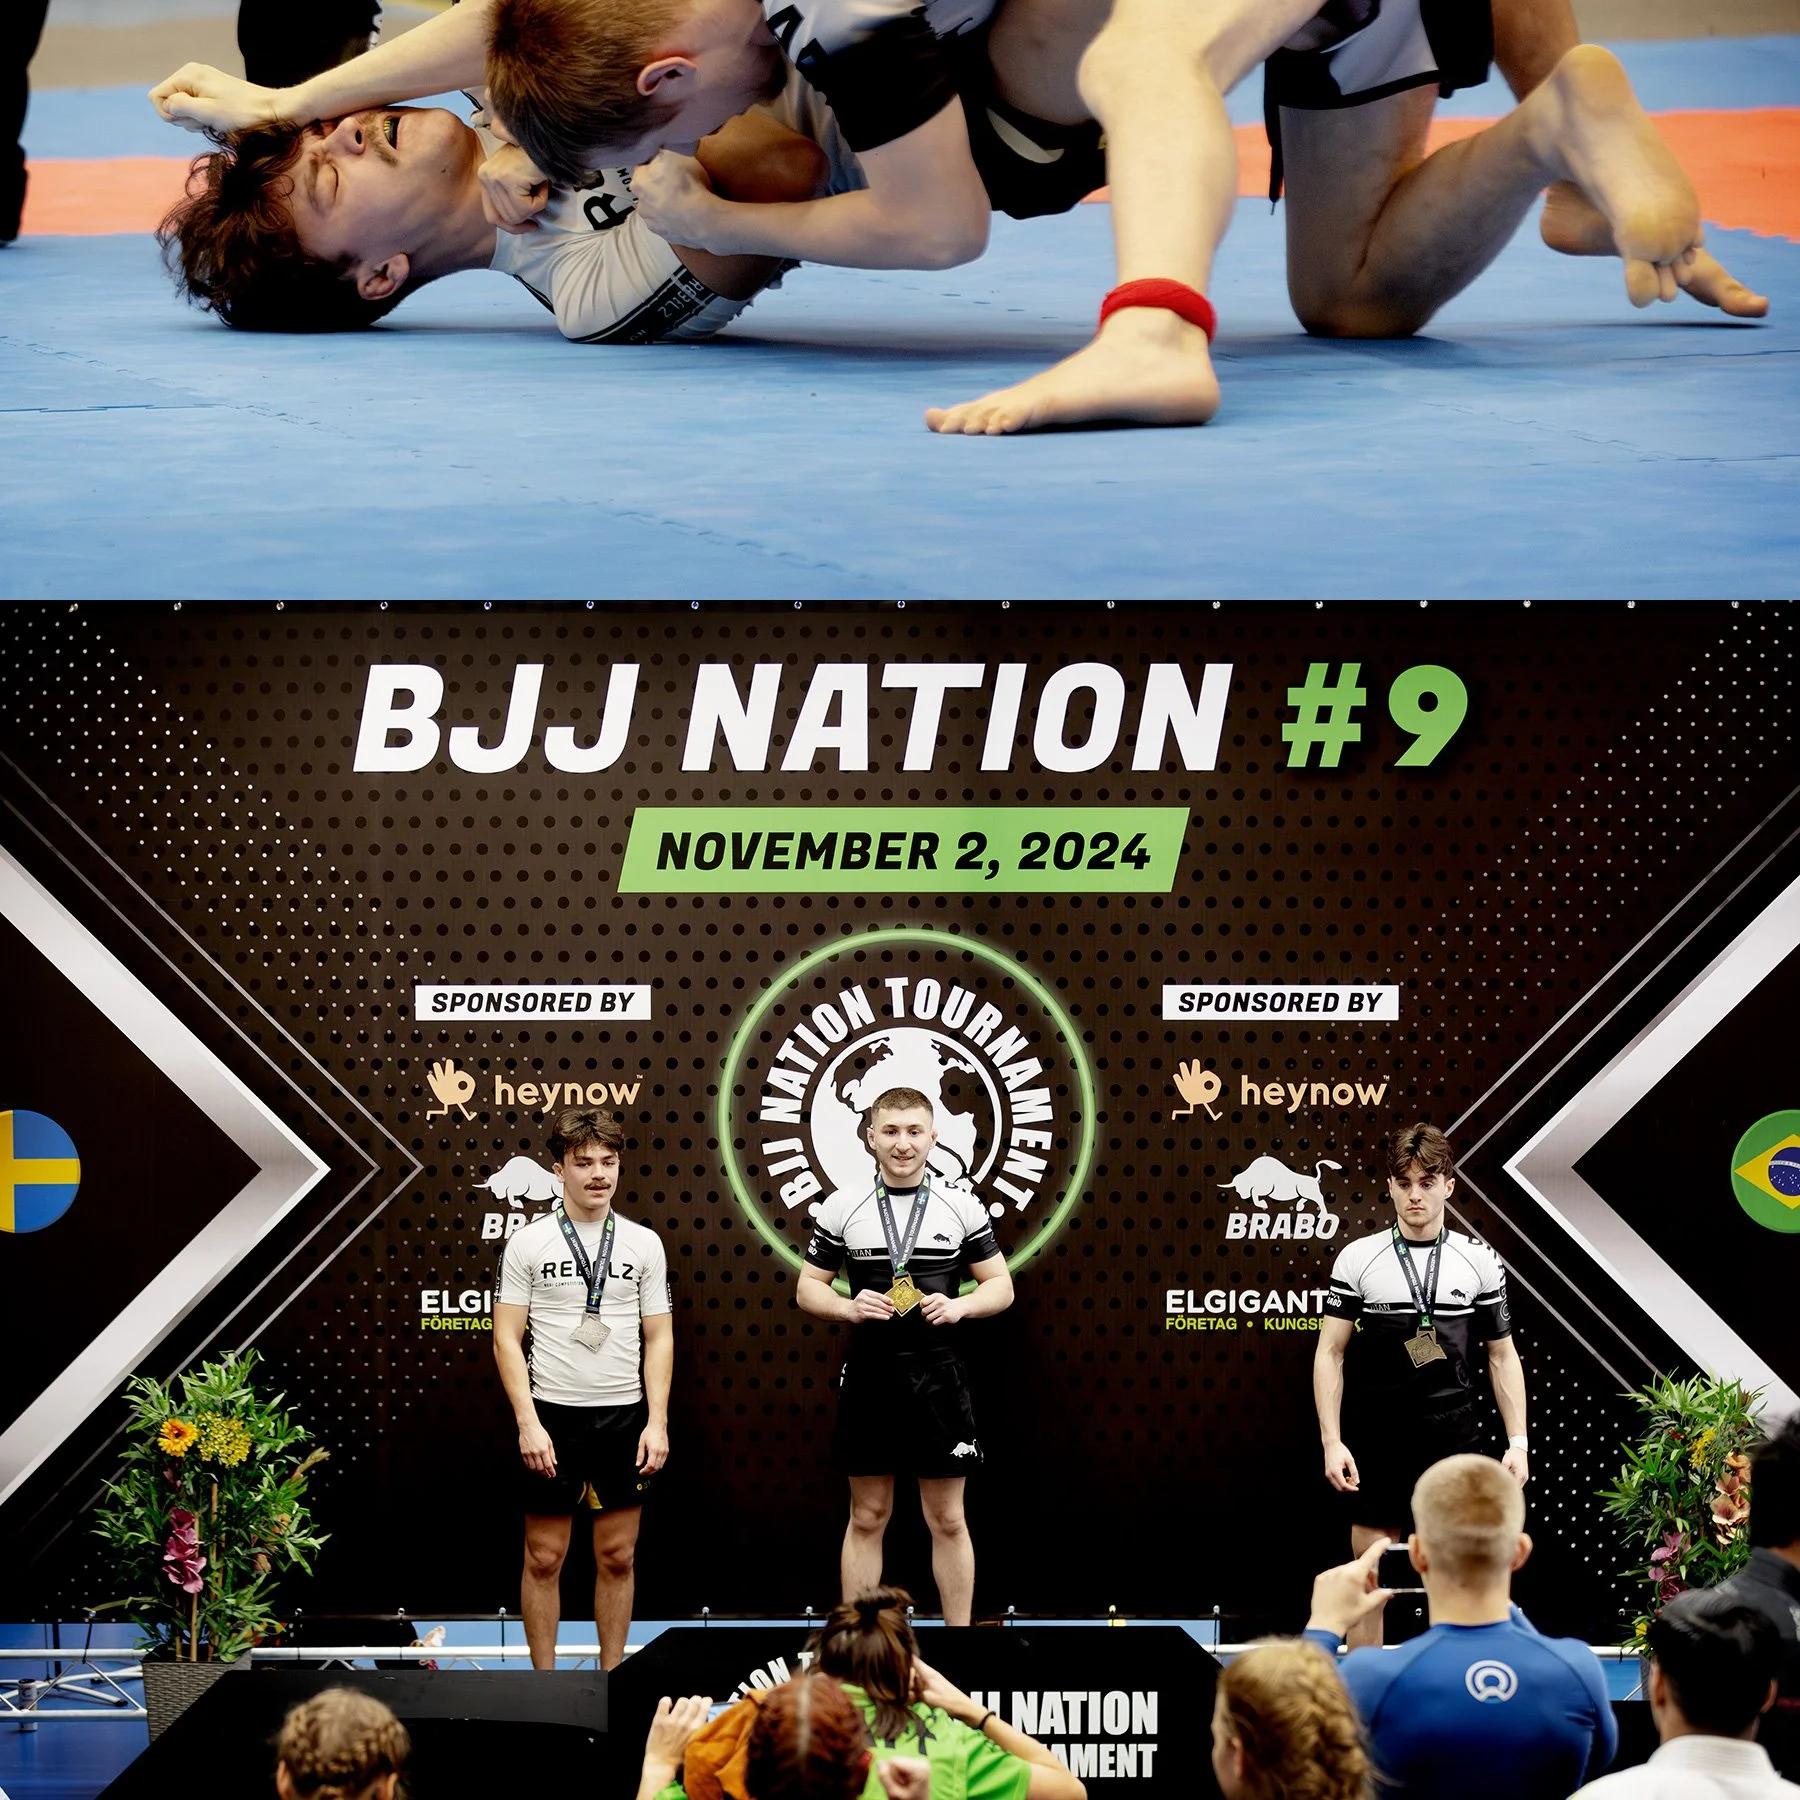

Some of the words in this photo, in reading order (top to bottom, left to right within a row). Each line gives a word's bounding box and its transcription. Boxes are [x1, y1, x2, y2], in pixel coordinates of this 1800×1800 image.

[353, 663, 640, 774] BJJ
[681, 662, 1234, 773] NATION
[1281, 662, 1469, 768] #9
[656, 831, 940, 871] NOVEMBER
[954, 831, 1000, 880] 2,
[1017, 831, 1151, 871] 2024
[431, 992, 592, 1013] SPONSORED
[600, 992, 635, 1012] BY
[1178, 991, 1340, 1013] SPONSORED
[1347, 991, 1384, 1012] BY
[760, 984, 877, 1124] NATION
[495, 1074, 641, 1113] heynow
[884, 976, 1054, 1212] TOURNAMENT
[1241, 1074, 1387, 1113] heynow
[761, 1137, 822, 1211] BJJ
[481, 1212, 538, 1239] BR
[1225, 1212, 1340, 1240] BRABO
[541, 1261, 634, 1280] RELZ
[421, 1315, 493, 1330] FÖRETAG
[1166, 1315, 1238, 1331] FÖRETAG
[1011, 1691, 1158, 1735] NATION
